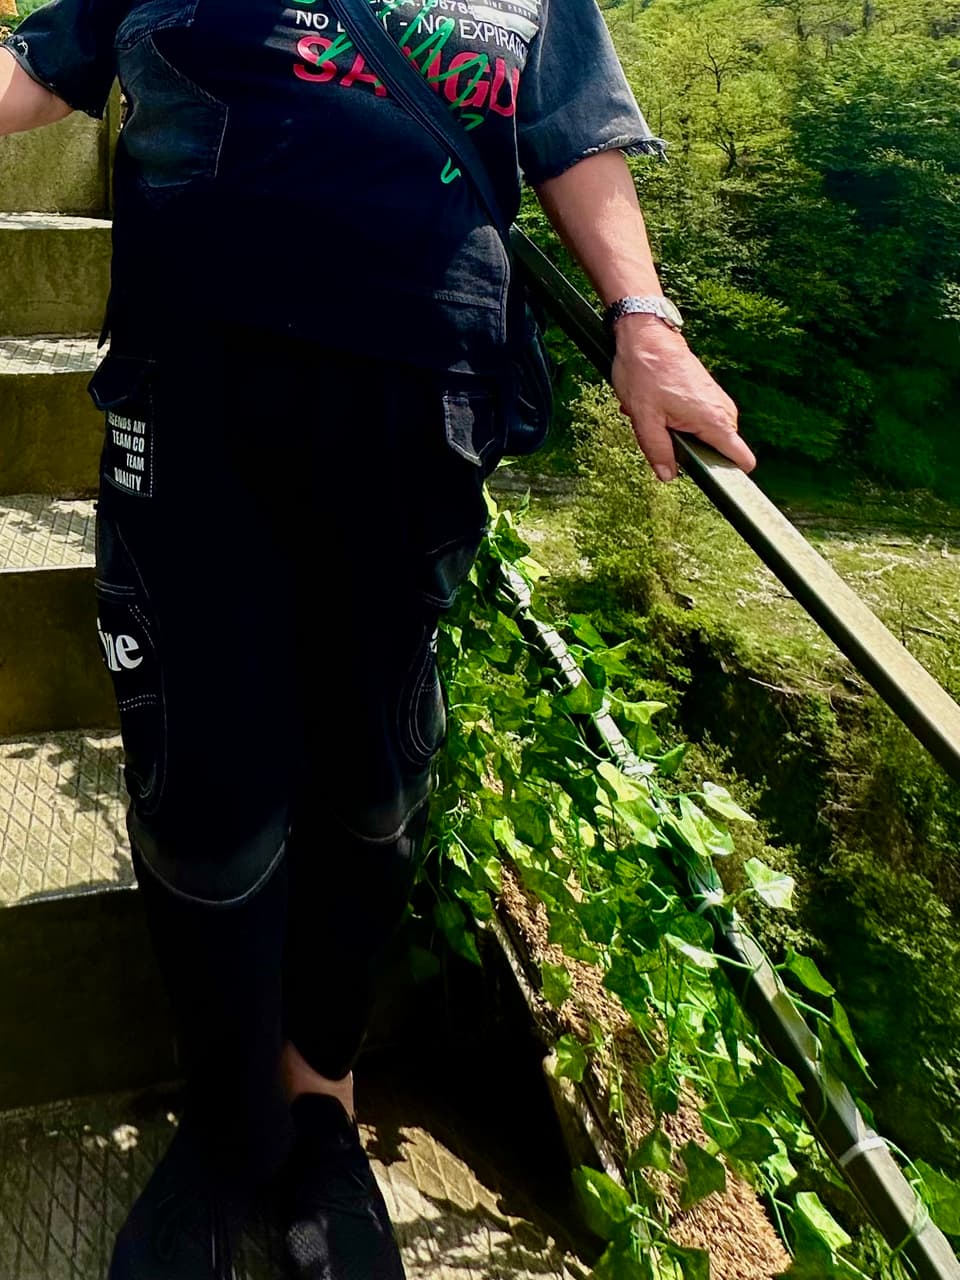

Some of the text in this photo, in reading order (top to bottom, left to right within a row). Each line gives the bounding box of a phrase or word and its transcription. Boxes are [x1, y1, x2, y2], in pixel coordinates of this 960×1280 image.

[296, 10, 329, 30] NO
[112, 429, 131, 450] TEAM
[126, 452, 145, 472] TEAM
